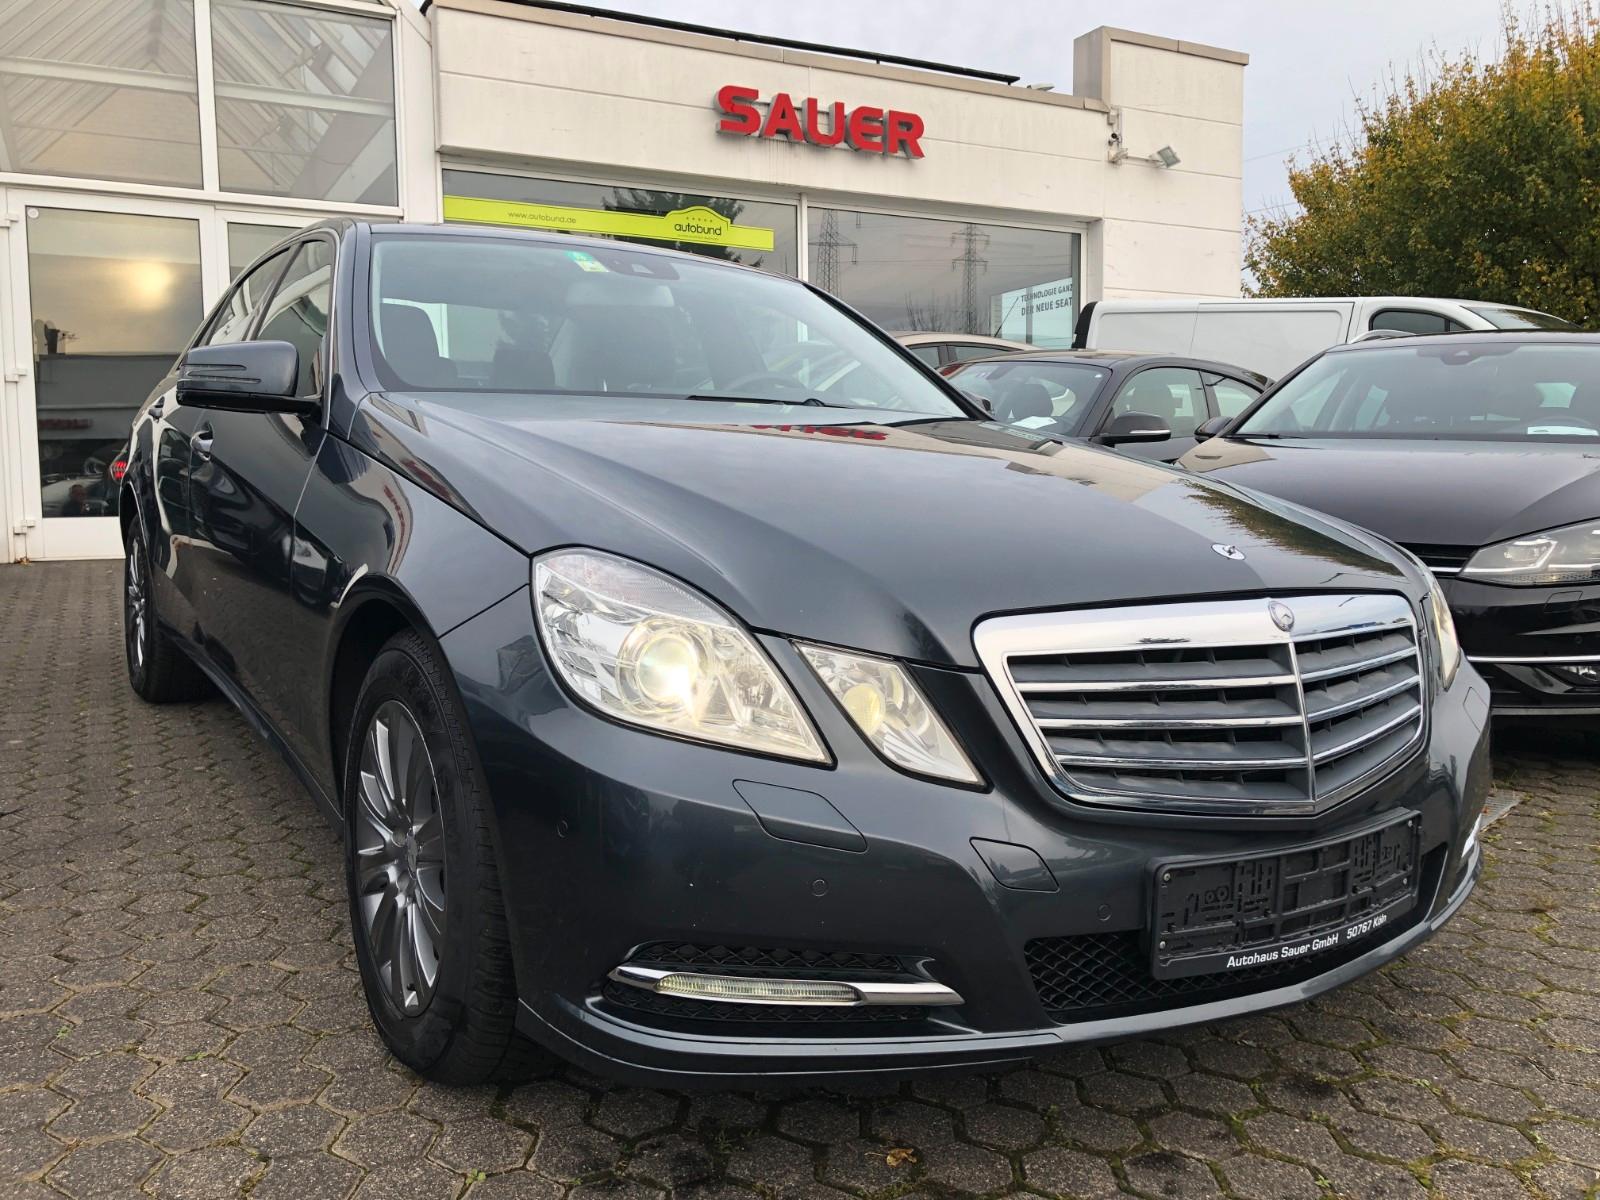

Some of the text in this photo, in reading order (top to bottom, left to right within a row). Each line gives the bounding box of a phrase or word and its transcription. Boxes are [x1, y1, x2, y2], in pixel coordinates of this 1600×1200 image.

[715, 85, 925, 159] SAUER
[507, 211, 576, 224] www.autobund.de
[674, 223, 721, 236] autobund
[1021, 297, 1072, 316] DER NEUE SEAT
[1226, 914, 1387, 968] Autohaus Sauer GmbH 50767 Köln
